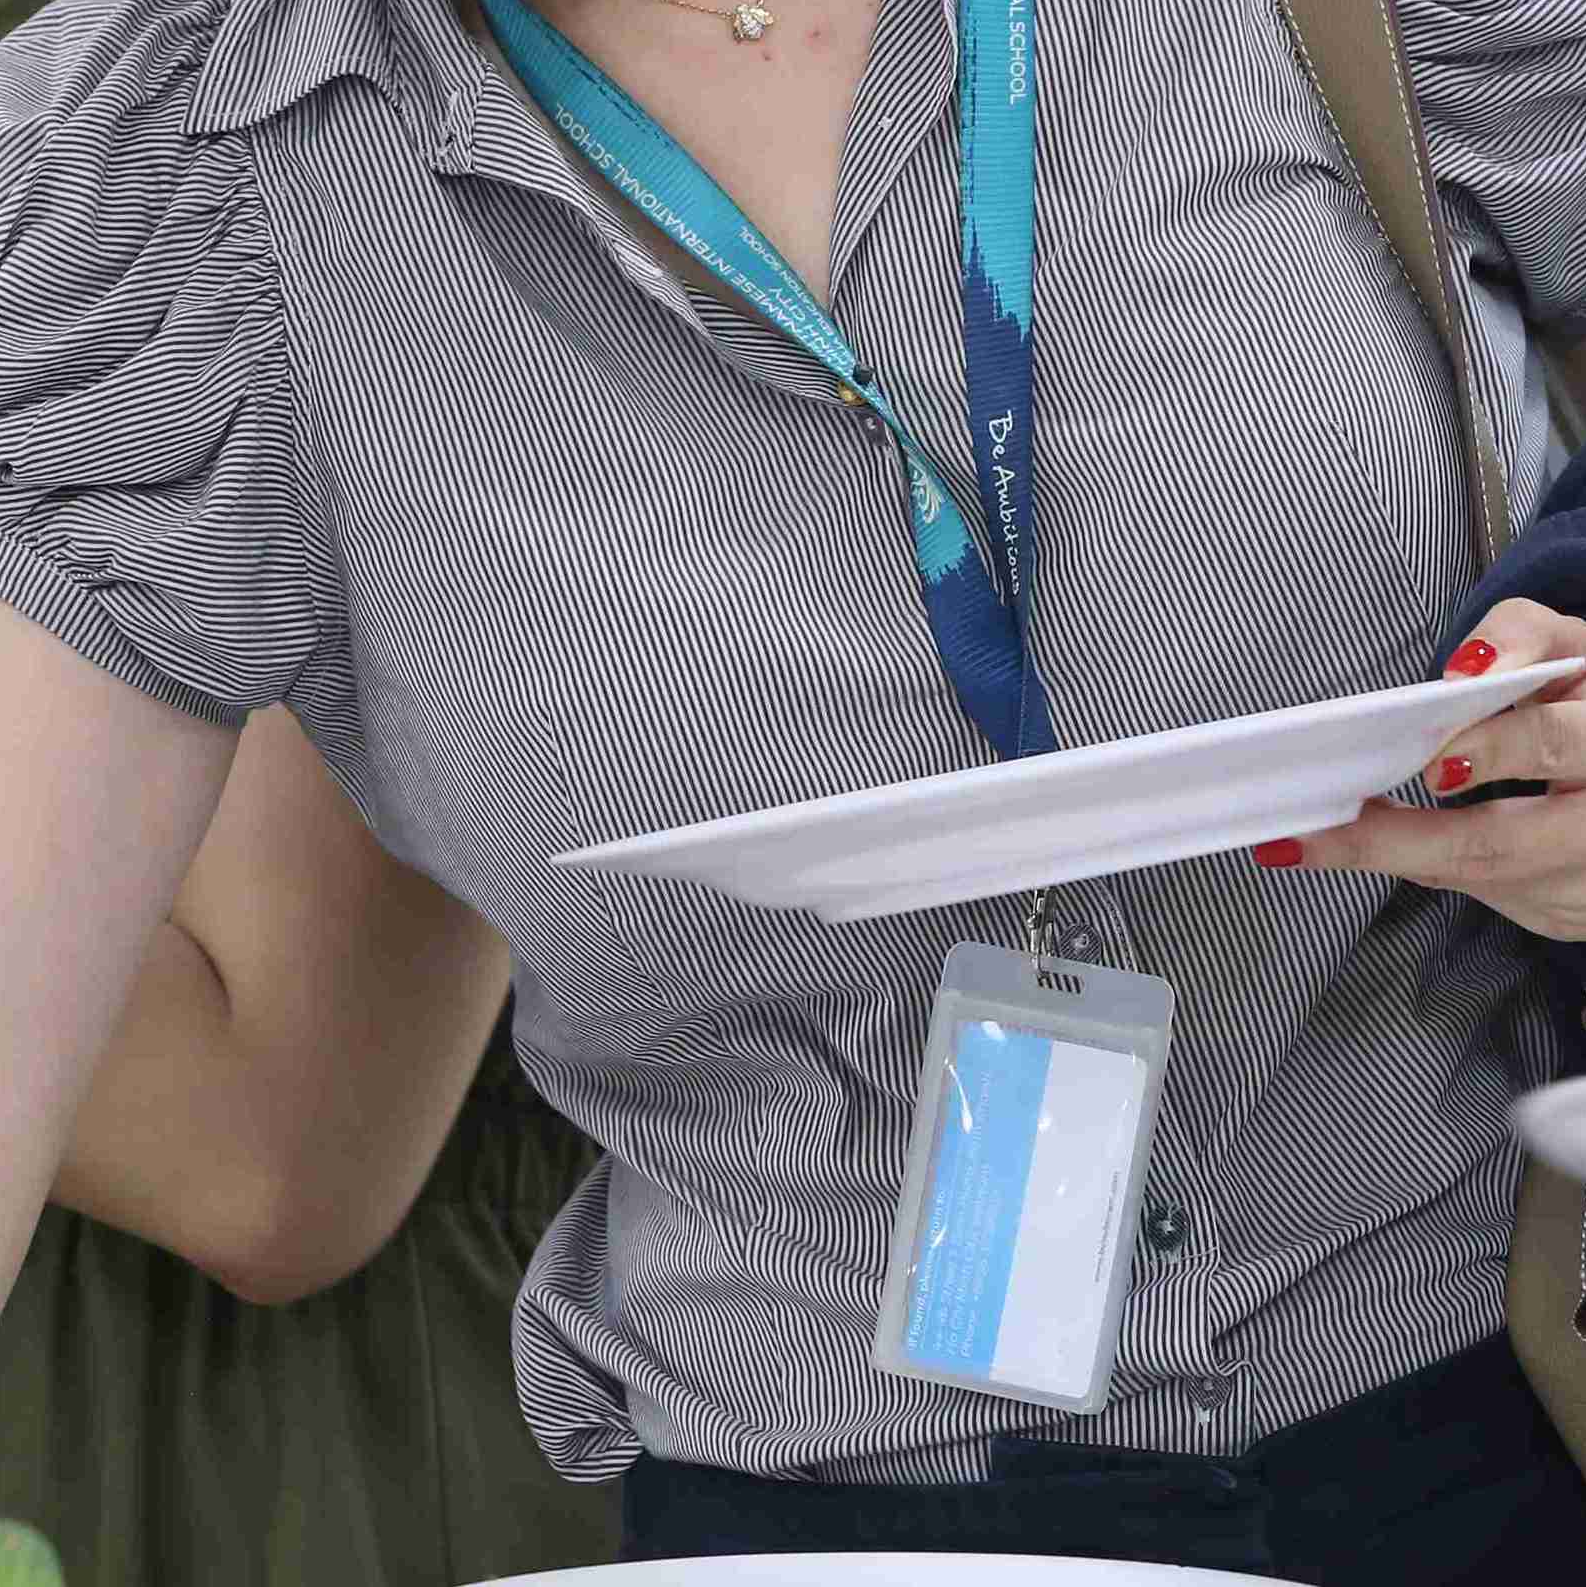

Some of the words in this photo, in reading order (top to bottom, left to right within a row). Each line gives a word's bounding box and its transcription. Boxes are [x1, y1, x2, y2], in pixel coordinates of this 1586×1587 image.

[1009, 21, 1026, 105] SCHOOL
[555, 102, 616, 169] SCHOOL
[613, 163, 735, 277] INTERNATIONAL
[769, 286, 806, 322] CITY
[989, 409, 1013, 460] Be
[992, 464, 1021, 596] Ambitious
